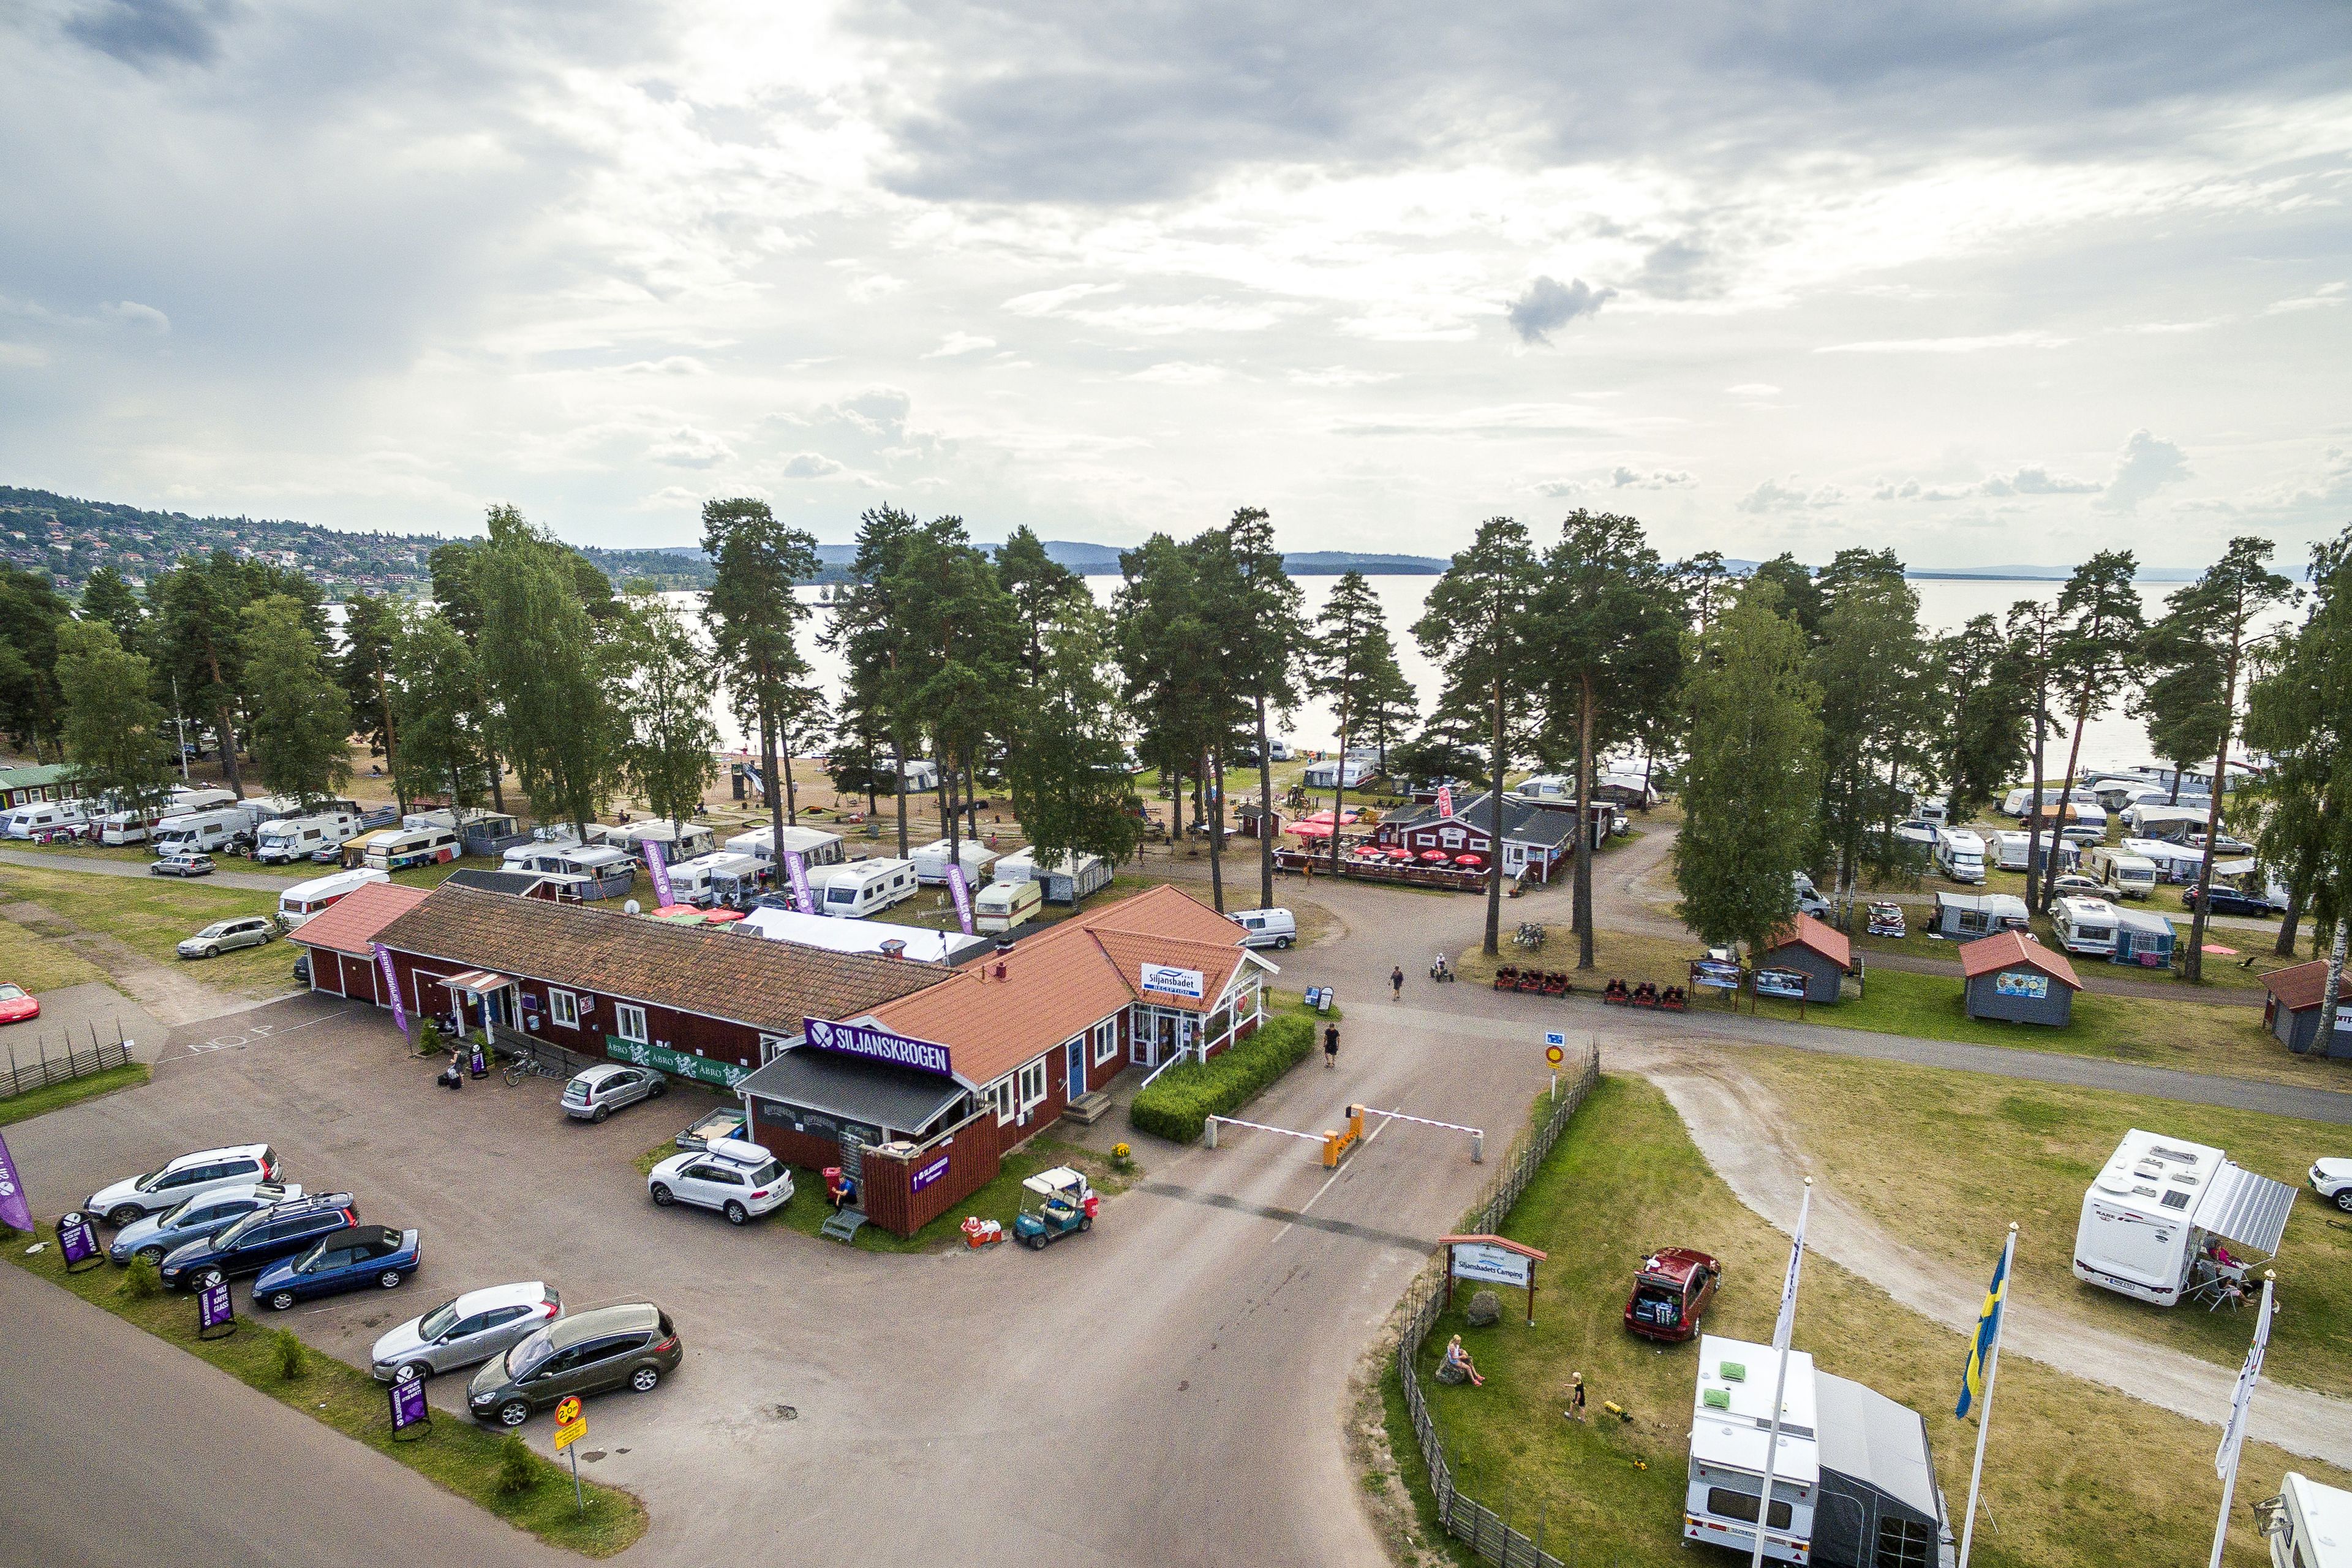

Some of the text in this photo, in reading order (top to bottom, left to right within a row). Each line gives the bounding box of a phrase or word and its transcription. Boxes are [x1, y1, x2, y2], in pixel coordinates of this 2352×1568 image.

[1150, 973, 1194, 989] Siljansbadet
[1153, 986, 1189, 995] RECEPTION
[835, 1028, 946, 1071] SILJANSKROGEN
[1459, 1262, 1523, 1280] Siljansbadets Camping
[214, 1292, 228, 1305] KAFFE
[214, 1301, 228, 1313] GLASS
